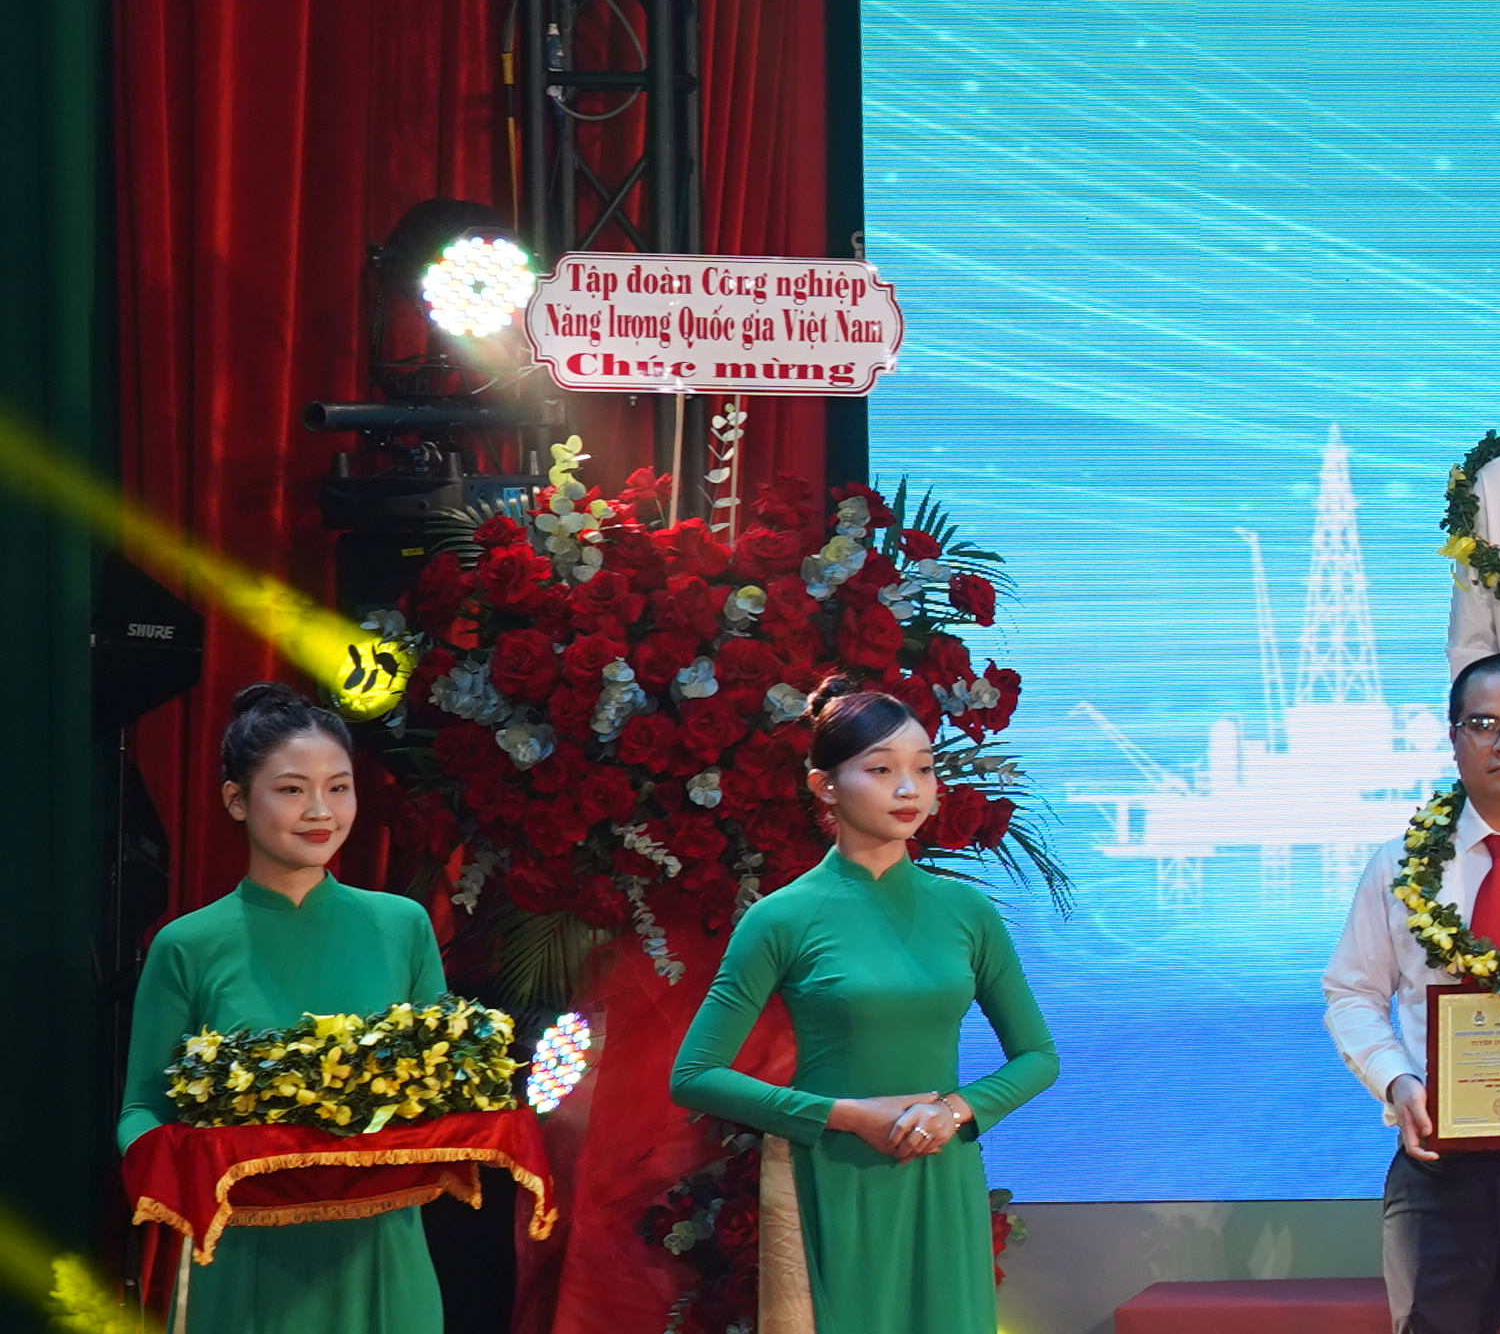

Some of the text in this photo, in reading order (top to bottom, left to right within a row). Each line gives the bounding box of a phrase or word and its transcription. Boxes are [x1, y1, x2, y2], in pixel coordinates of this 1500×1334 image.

[566, 263, 867, 306] Tập đoàn Công nghiệp
[545, 303, 884, 351] Năng lượng Quốc gia Việt Nam
[566, 352, 857, 387] Chúc mừng
[127, 622, 176, 640] SHURE
